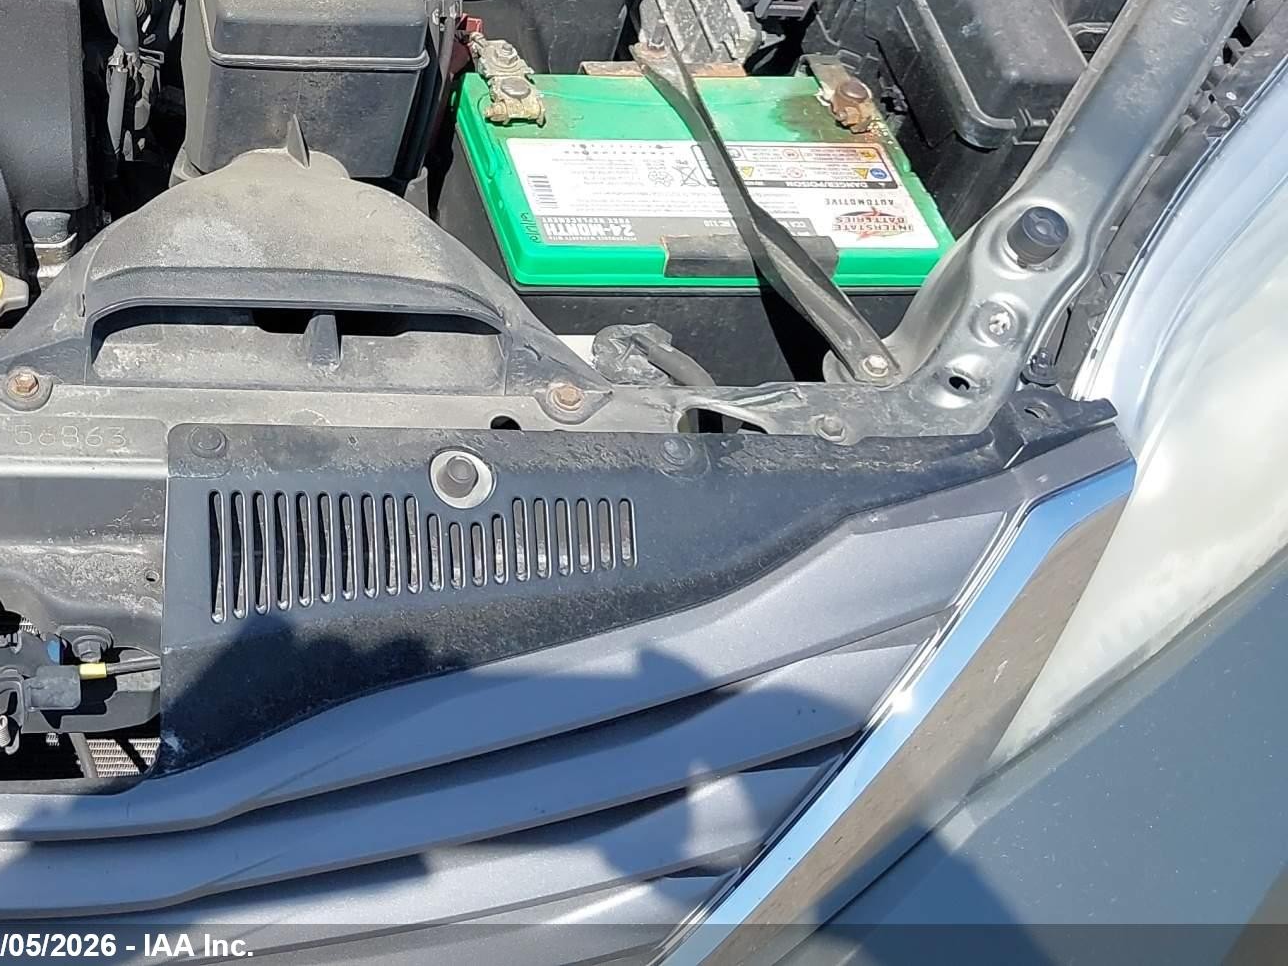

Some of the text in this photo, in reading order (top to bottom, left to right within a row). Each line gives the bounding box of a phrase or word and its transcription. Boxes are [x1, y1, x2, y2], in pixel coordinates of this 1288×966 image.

[824, 198, 894, 206] AUTOMOTIVE
[834, 216, 906, 224] BATTERIES
[543, 223, 634, 237] 24-MONTH
[832, 224, 914, 232] INTERSTATE
[14, 424, 127, 447] 56863
